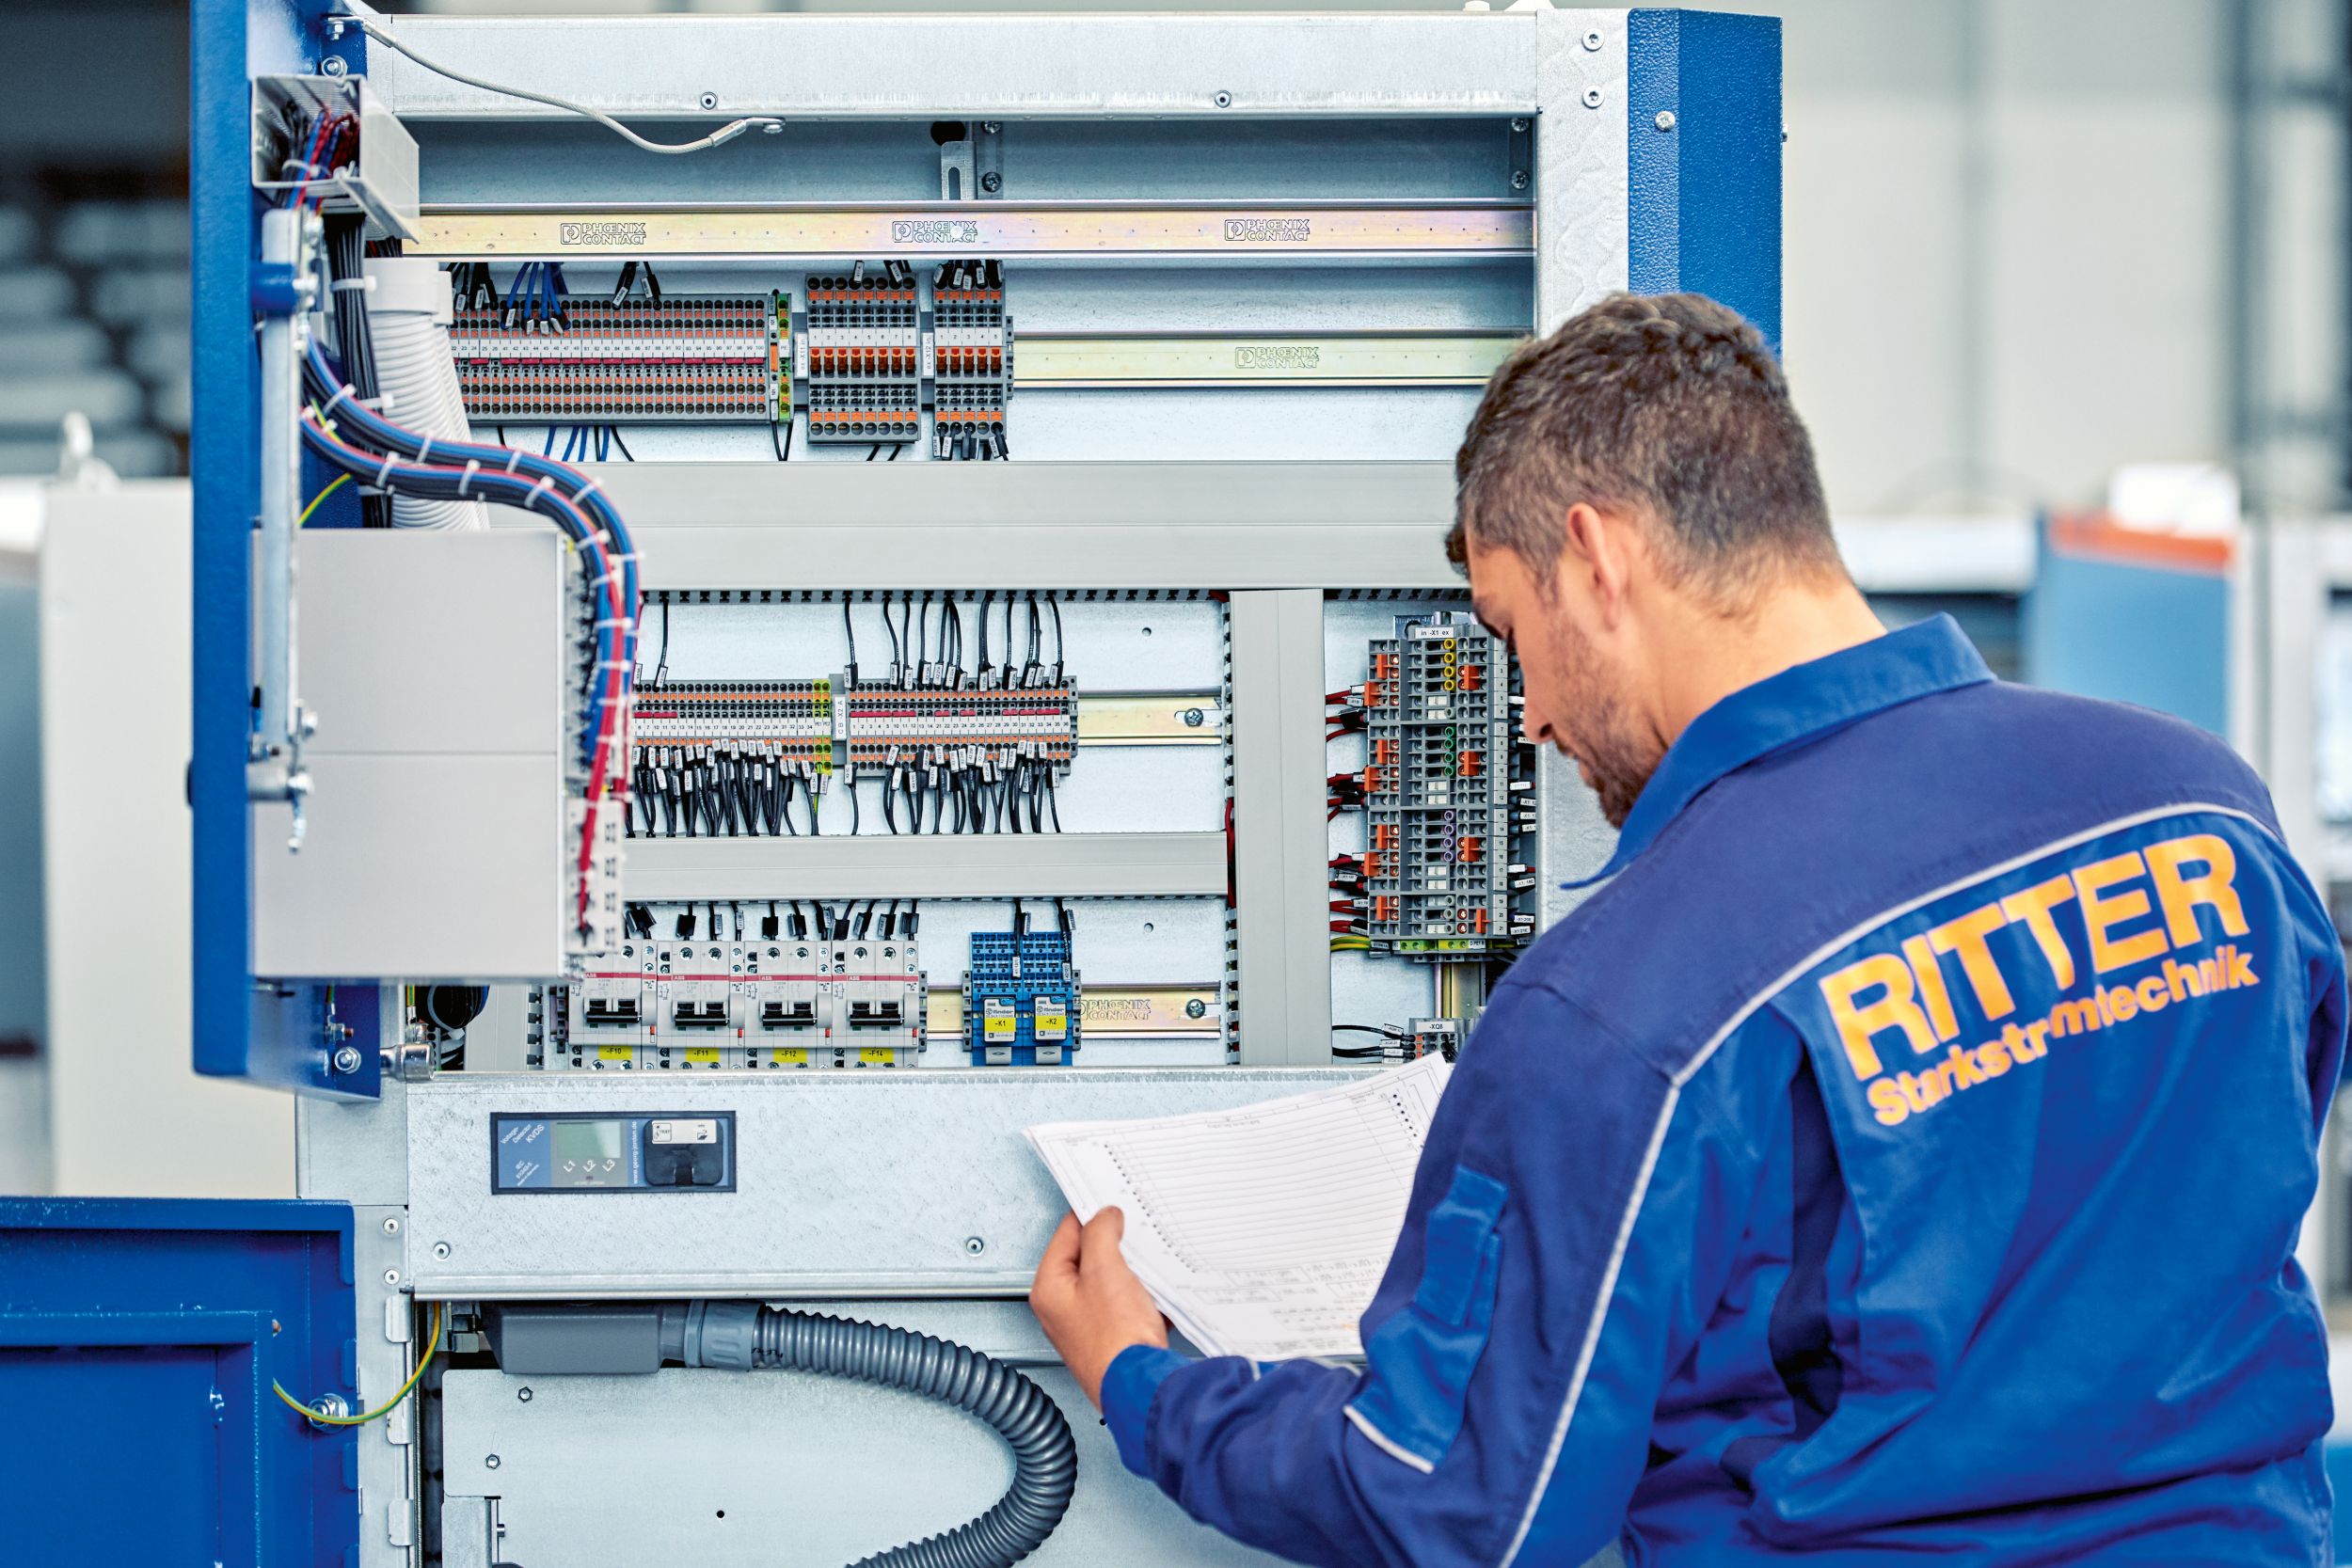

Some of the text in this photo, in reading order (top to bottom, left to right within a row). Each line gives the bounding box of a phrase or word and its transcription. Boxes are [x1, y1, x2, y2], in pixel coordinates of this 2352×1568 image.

[582, 234, 646, 245] CONTACT
[1247, 230, 1310, 241] CONTACT
[1256, 358, 1319, 369] CONTACT
[1819, 833, 2250, 1082] RITTER
[1089, 1010, 1152, 1021] CONTACT
[1867, 944, 2260, 1126] Starkstrmtechnik
[526, 1123, 545, 1144] KVDS
[563, 1159, 616, 1173] L1 L2 L3
